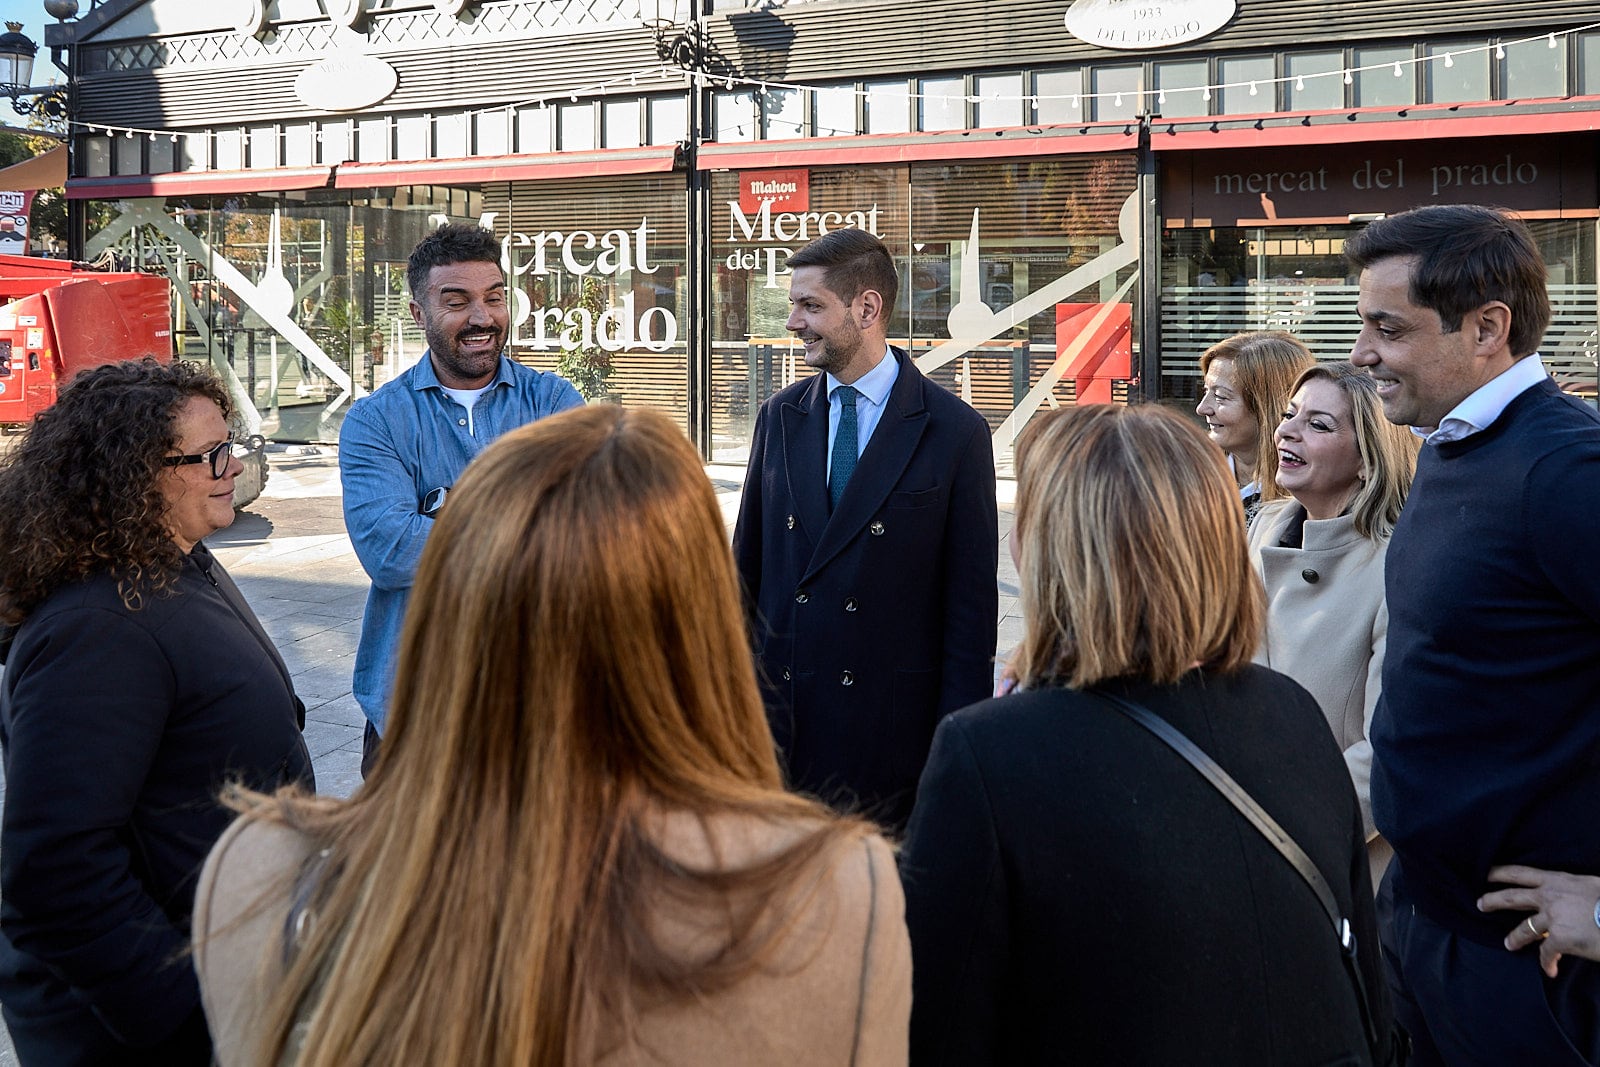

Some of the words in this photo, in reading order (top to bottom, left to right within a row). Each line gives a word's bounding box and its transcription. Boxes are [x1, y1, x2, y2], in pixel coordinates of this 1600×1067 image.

[1132, 7, 1163, 20] 1933
[1097, 27, 1131, 42] DEL
[1137, 20, 1200, 42] PRADO
[1213, 166, 1328, 194] mercat
[1352, 158, 1404, 190] del
[1431, 154, 1538, 196] prado
[751, 180, 797, 195] Mahou
[726, 248, 761, 271] del
